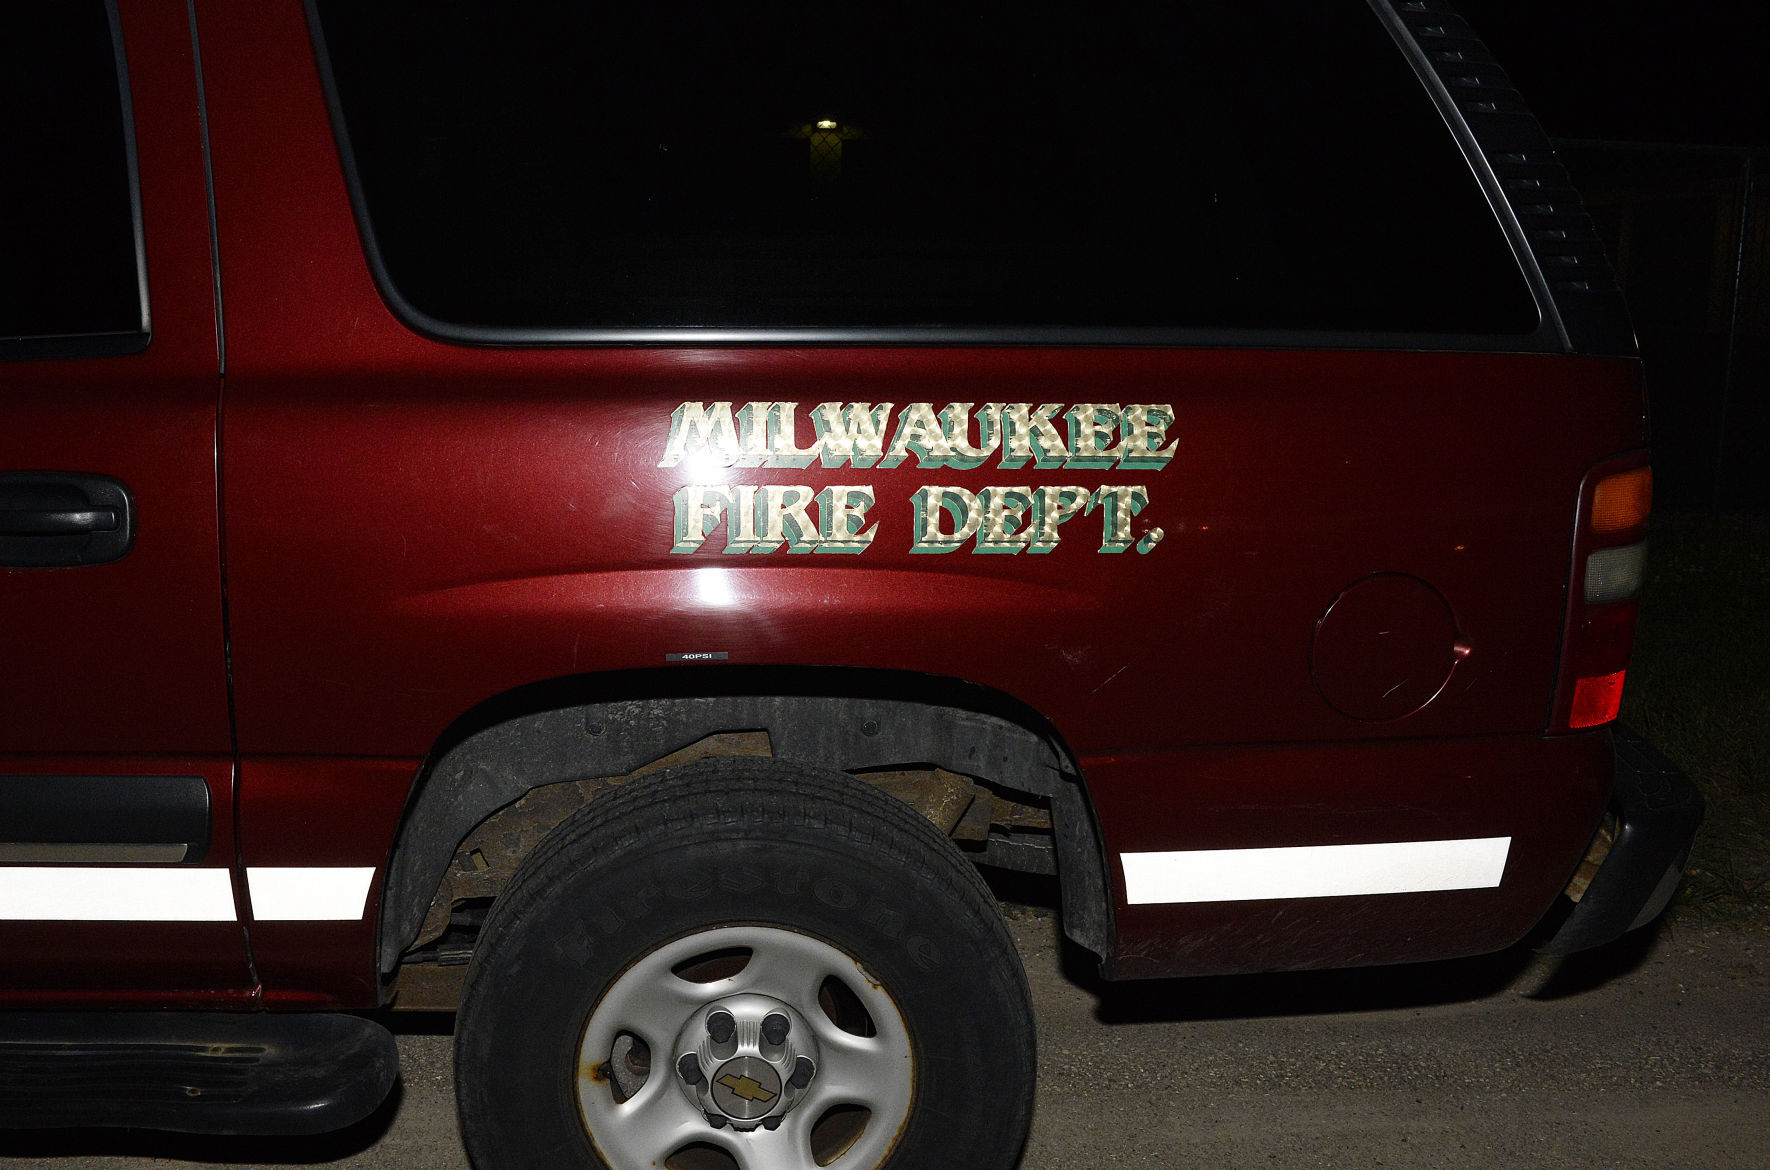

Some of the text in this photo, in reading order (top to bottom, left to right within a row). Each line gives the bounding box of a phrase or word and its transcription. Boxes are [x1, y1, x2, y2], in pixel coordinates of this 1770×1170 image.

[657, 401, 1180, 471] MILWAUKEE
[670, 484, 1165, 555] FIRE DEPT.
